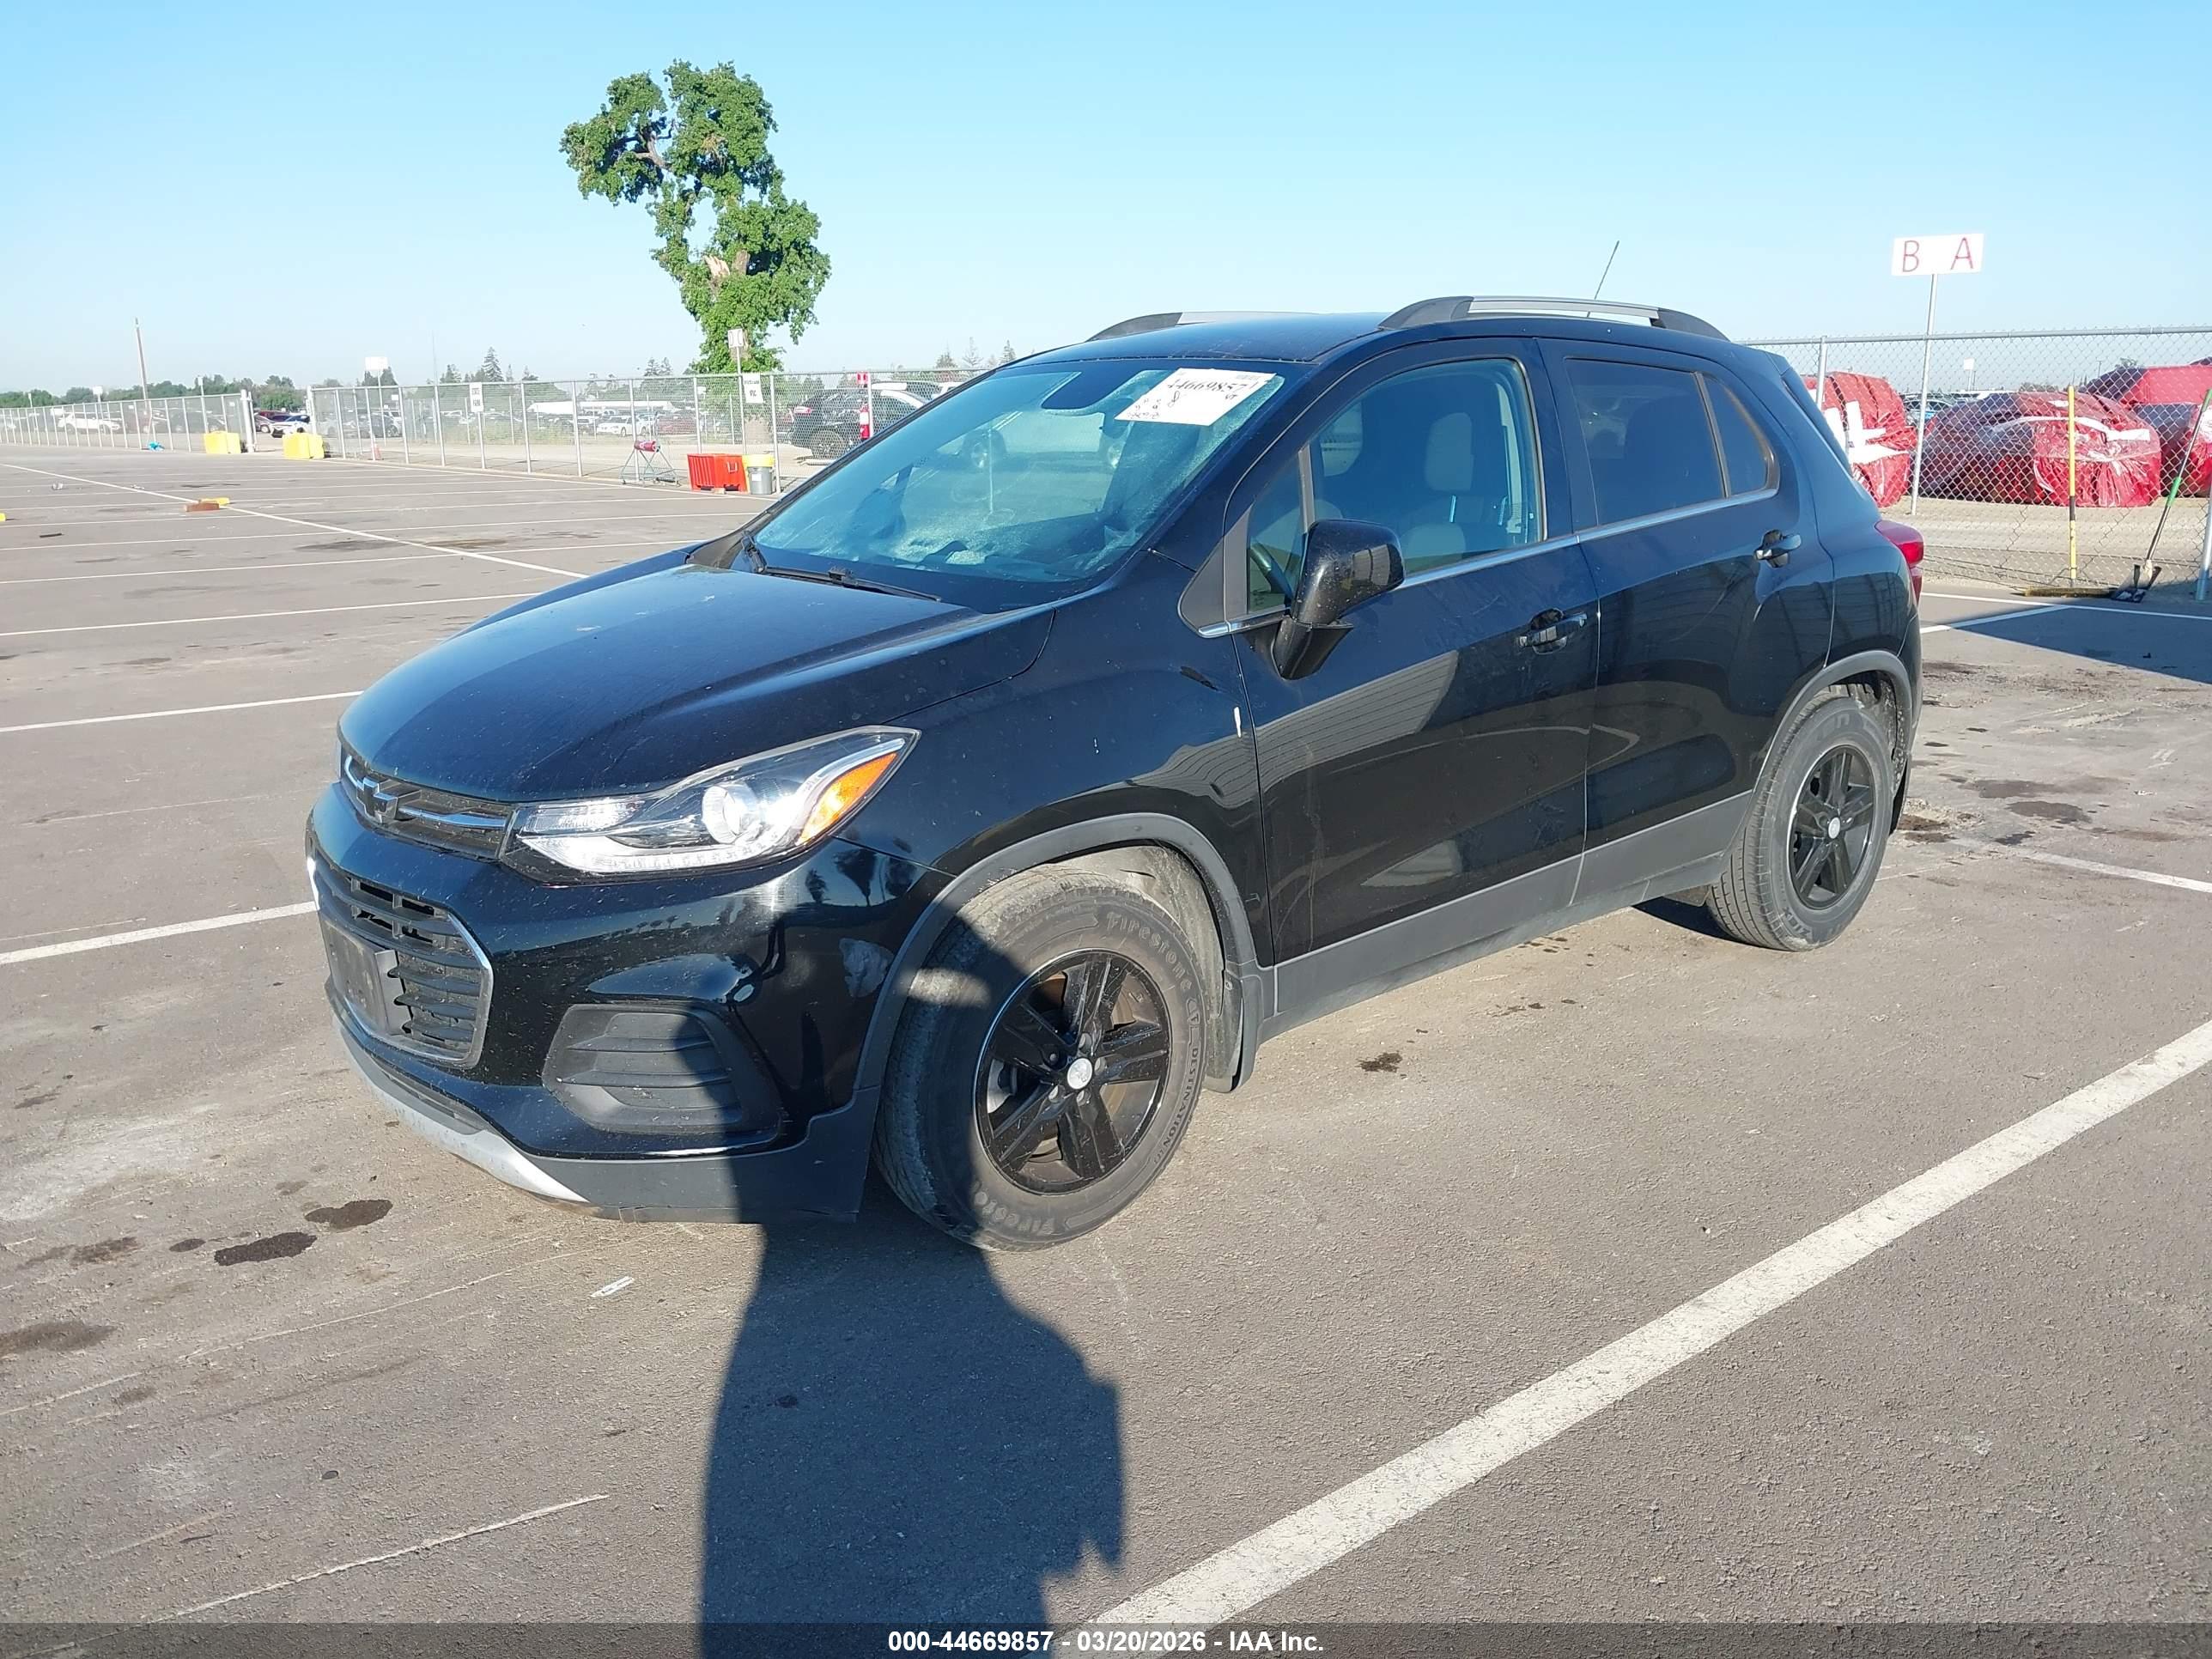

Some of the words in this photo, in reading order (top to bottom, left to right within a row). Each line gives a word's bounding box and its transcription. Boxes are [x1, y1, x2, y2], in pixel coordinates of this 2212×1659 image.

[1902, 240, 1920, 272] B
[1950, 237, 1973, 270] A
[1107, 911, 1194, 992] Firestone
[1164, 1048, 1200, 1147] DESTINATION
